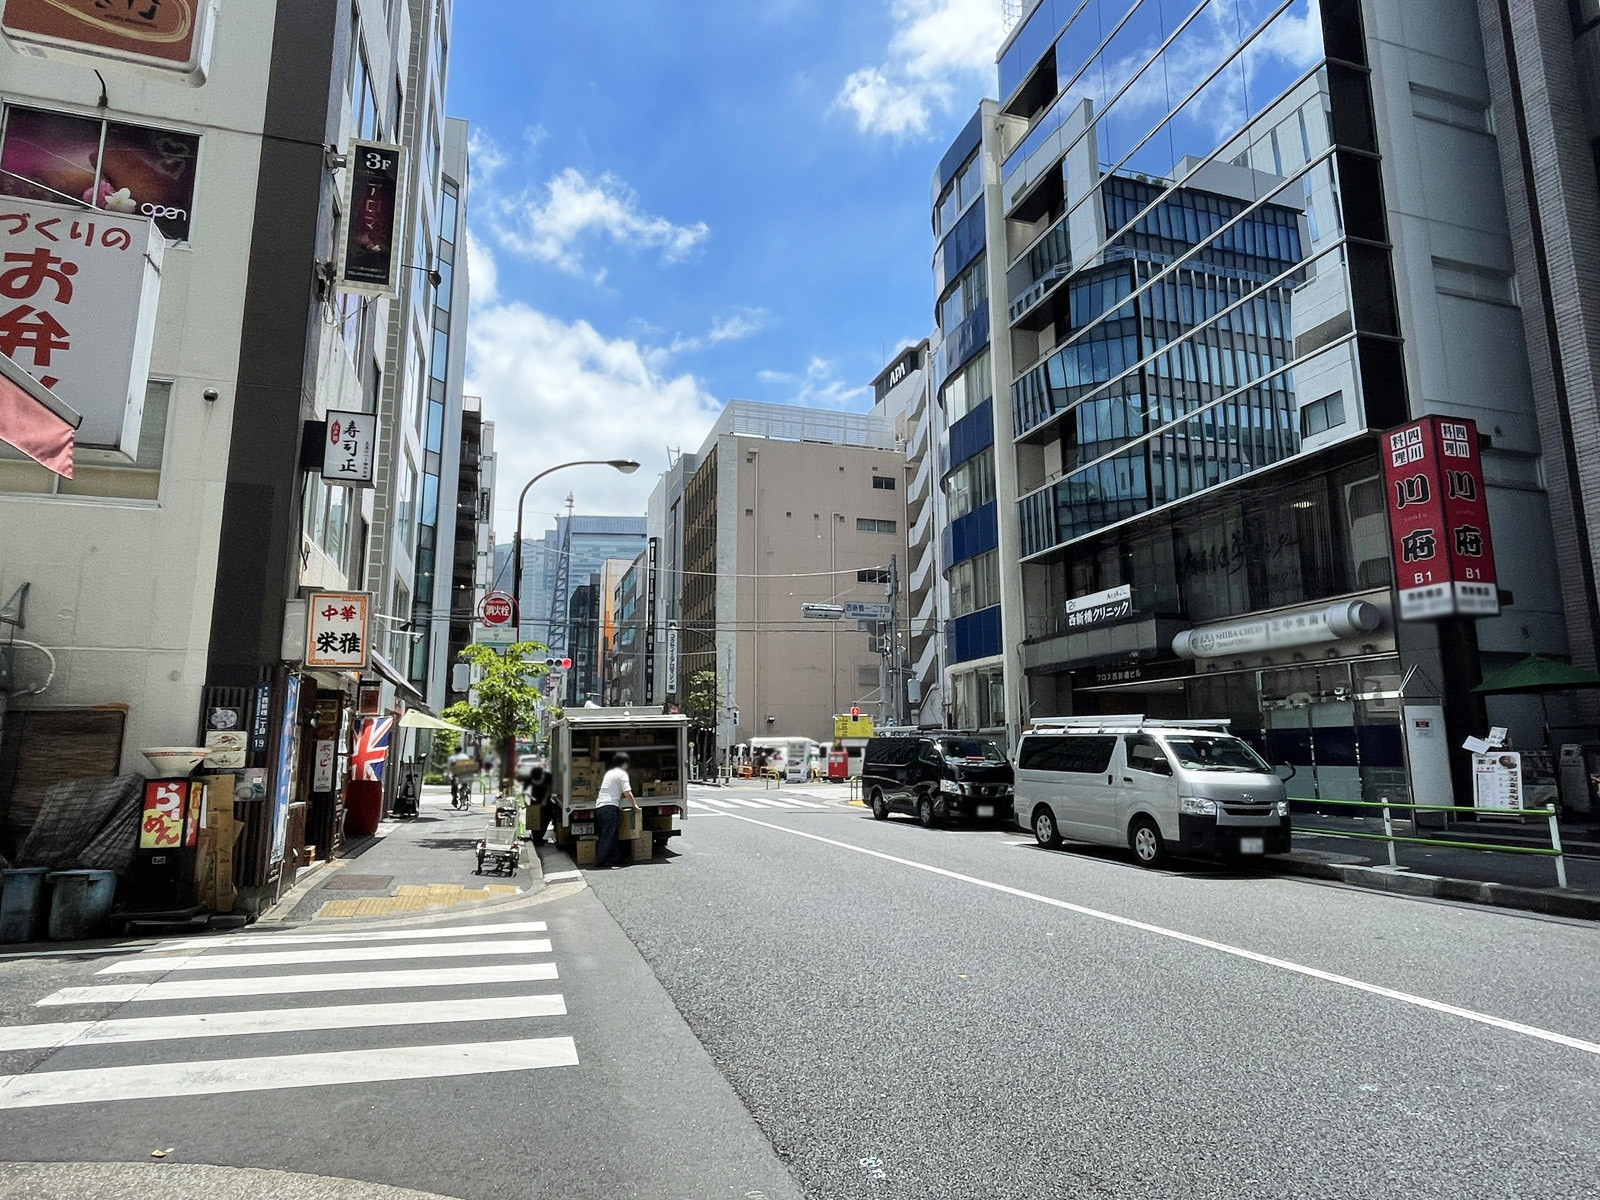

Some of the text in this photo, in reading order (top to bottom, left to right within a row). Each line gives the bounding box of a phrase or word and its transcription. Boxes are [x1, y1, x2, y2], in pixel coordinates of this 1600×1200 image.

[366, 152, 392, 170] 3F
[141, 202, 187, 221] open
[0, 247, 79, 388] お弁
[338, 420, 361, 473] 寿司正
[1414, 570, 1432, 584] B1
[1465, 567, 1480, 579] B1
[321, 605, 357, 622] 中華
[486, 605, 510, 616] 消火栓
[1068, 600, 1129, 627] 西新橋クリニック
[316, 631, 361, 655] 栄雅
[254, 739, 264, 748] 19
